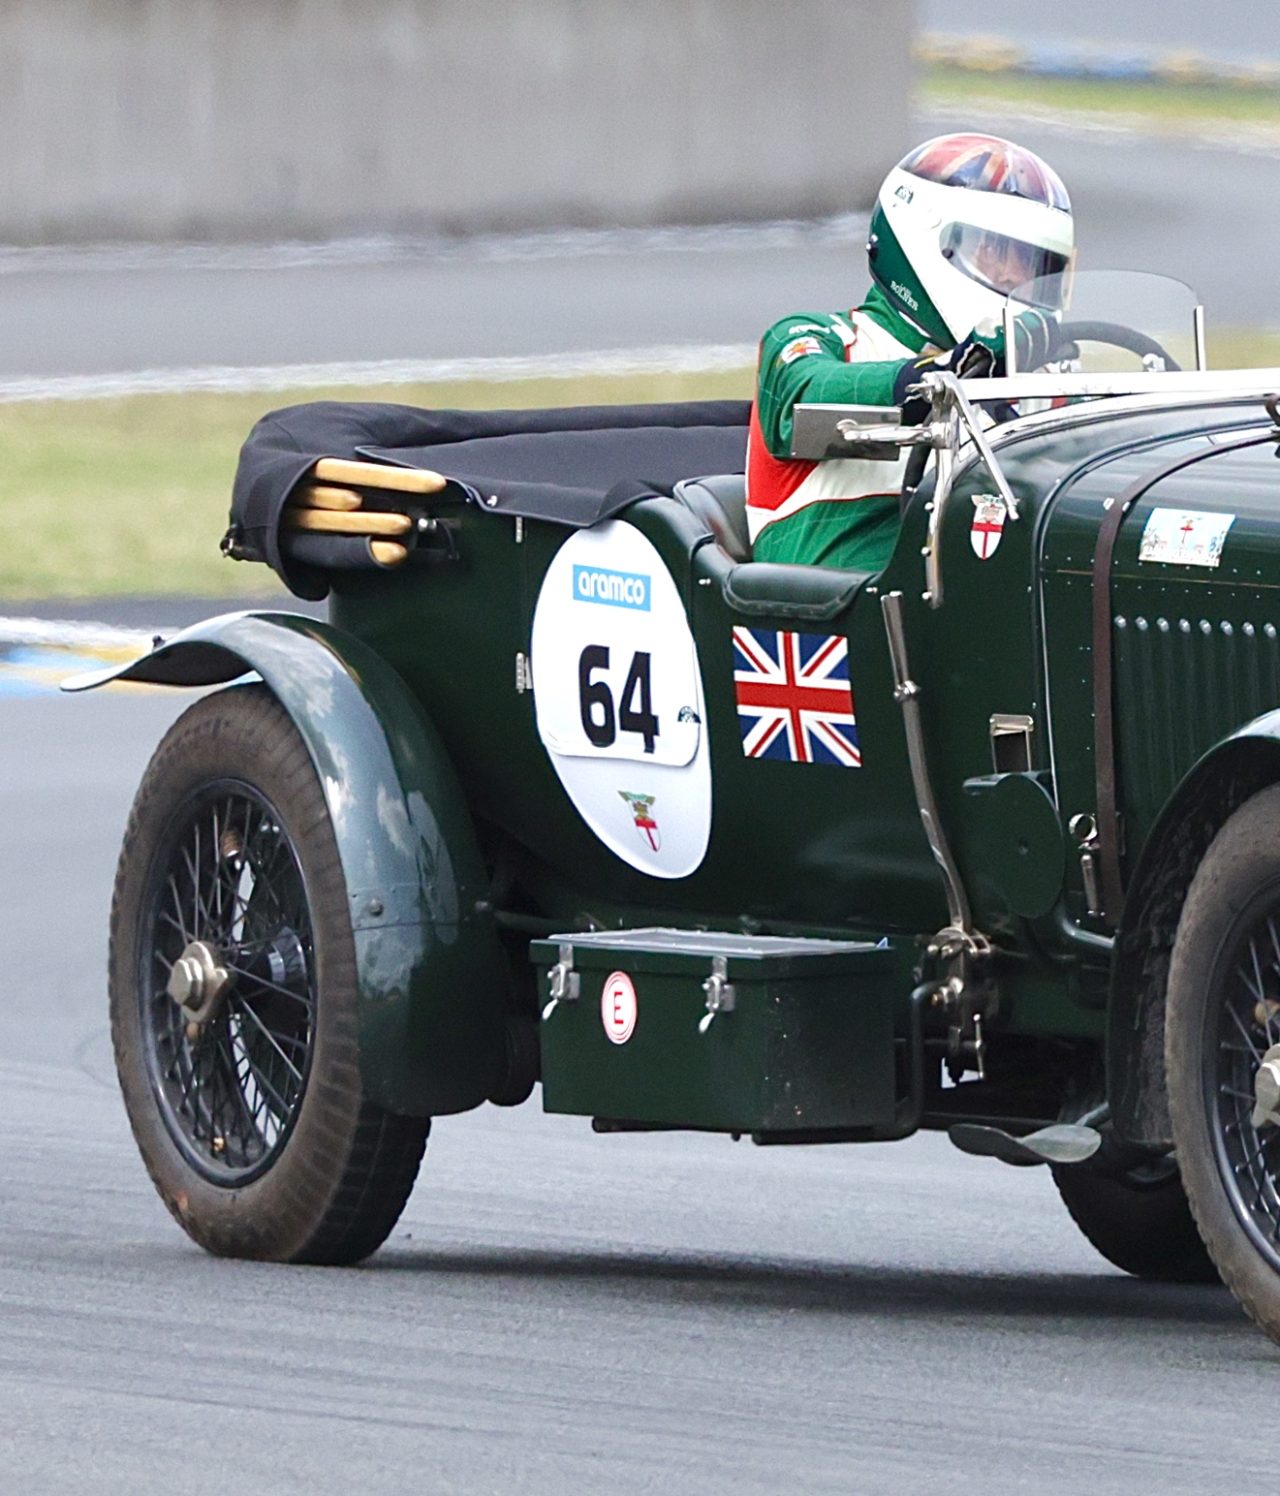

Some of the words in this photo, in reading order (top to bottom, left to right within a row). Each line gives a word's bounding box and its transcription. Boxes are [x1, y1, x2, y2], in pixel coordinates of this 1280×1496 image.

[578, 570, 646, 605] aramco
[578, 644, 660, 754] 64
[613, 991, 625, 1025] E
